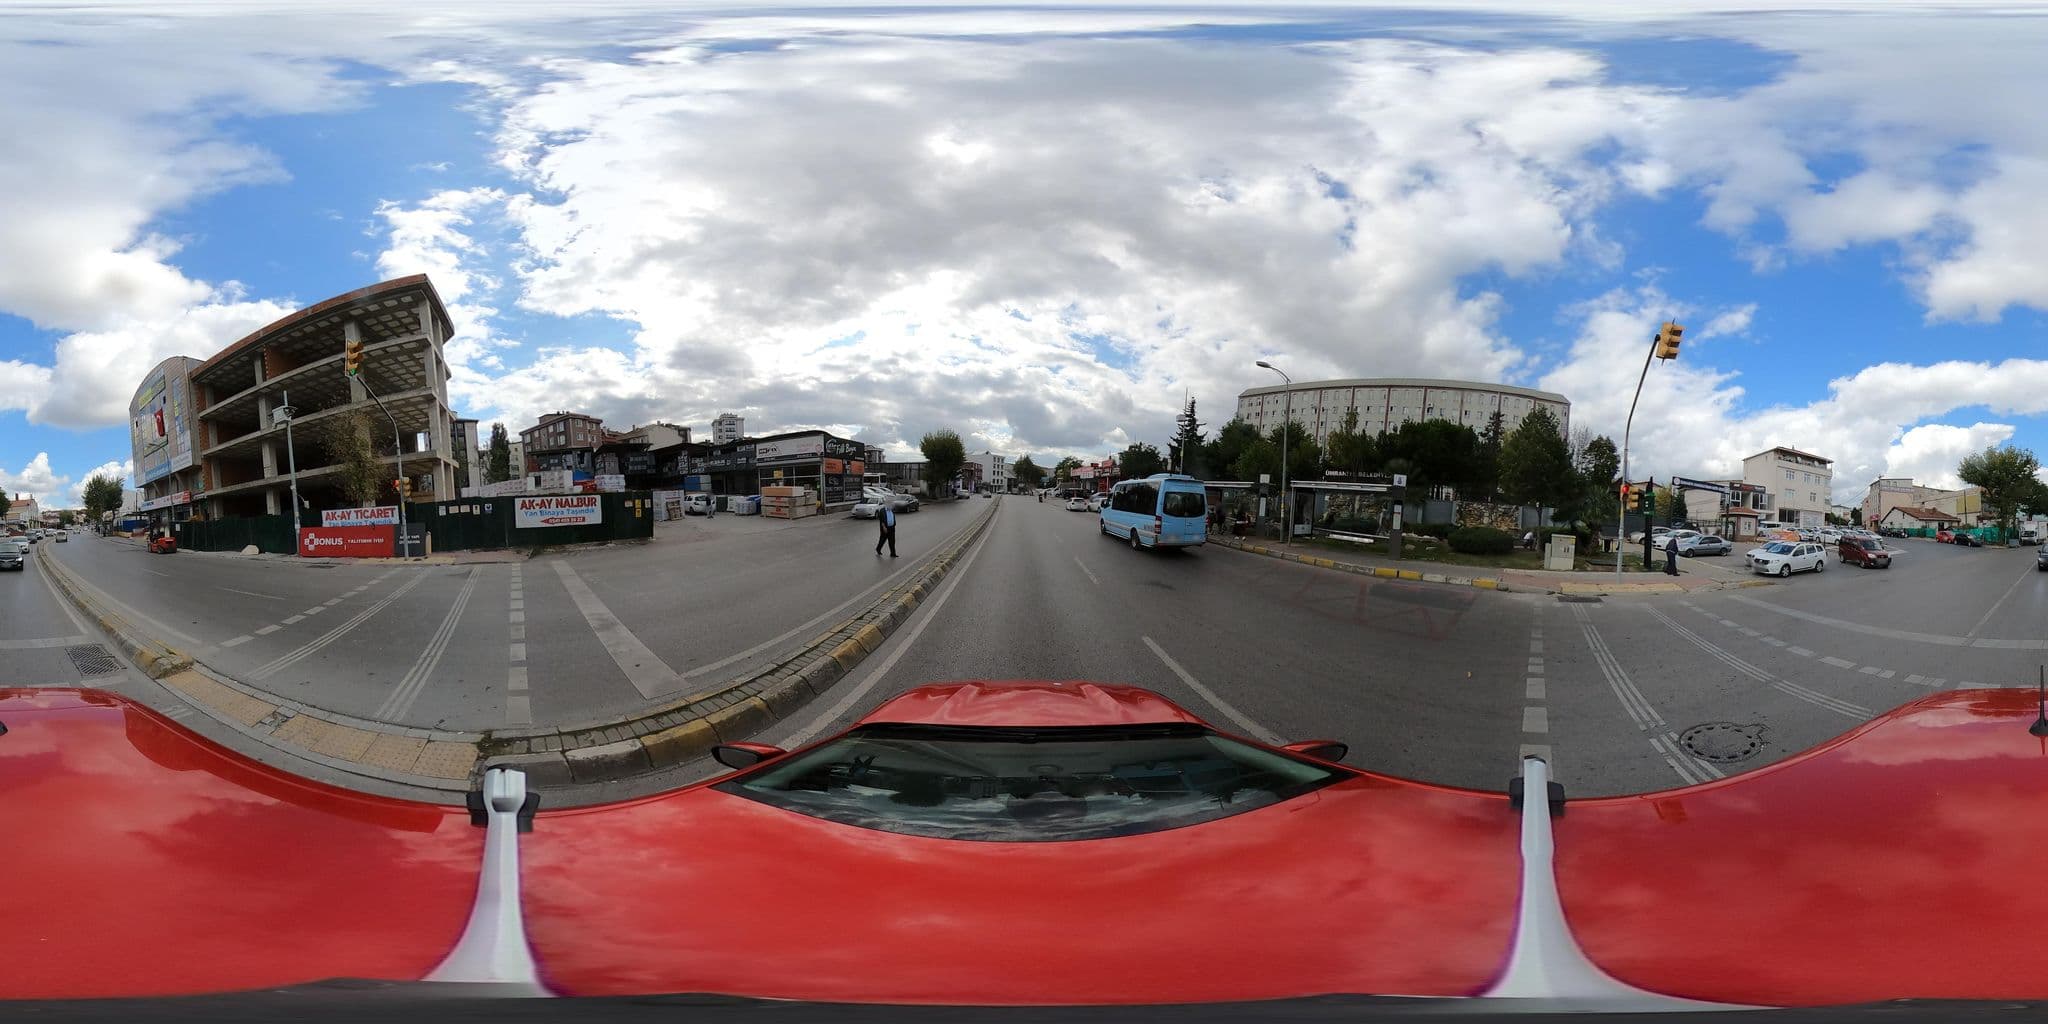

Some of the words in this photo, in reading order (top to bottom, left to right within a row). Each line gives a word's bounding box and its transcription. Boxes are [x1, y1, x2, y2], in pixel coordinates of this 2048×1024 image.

[520, 498, 554, 510] AK-AY
[556, 497, 597, 509] NALBUR
[325, 510, 352, 521] AK-AY
[524, 510, 538, 518] Yan
[314, 537, 343, 546] BONUS
